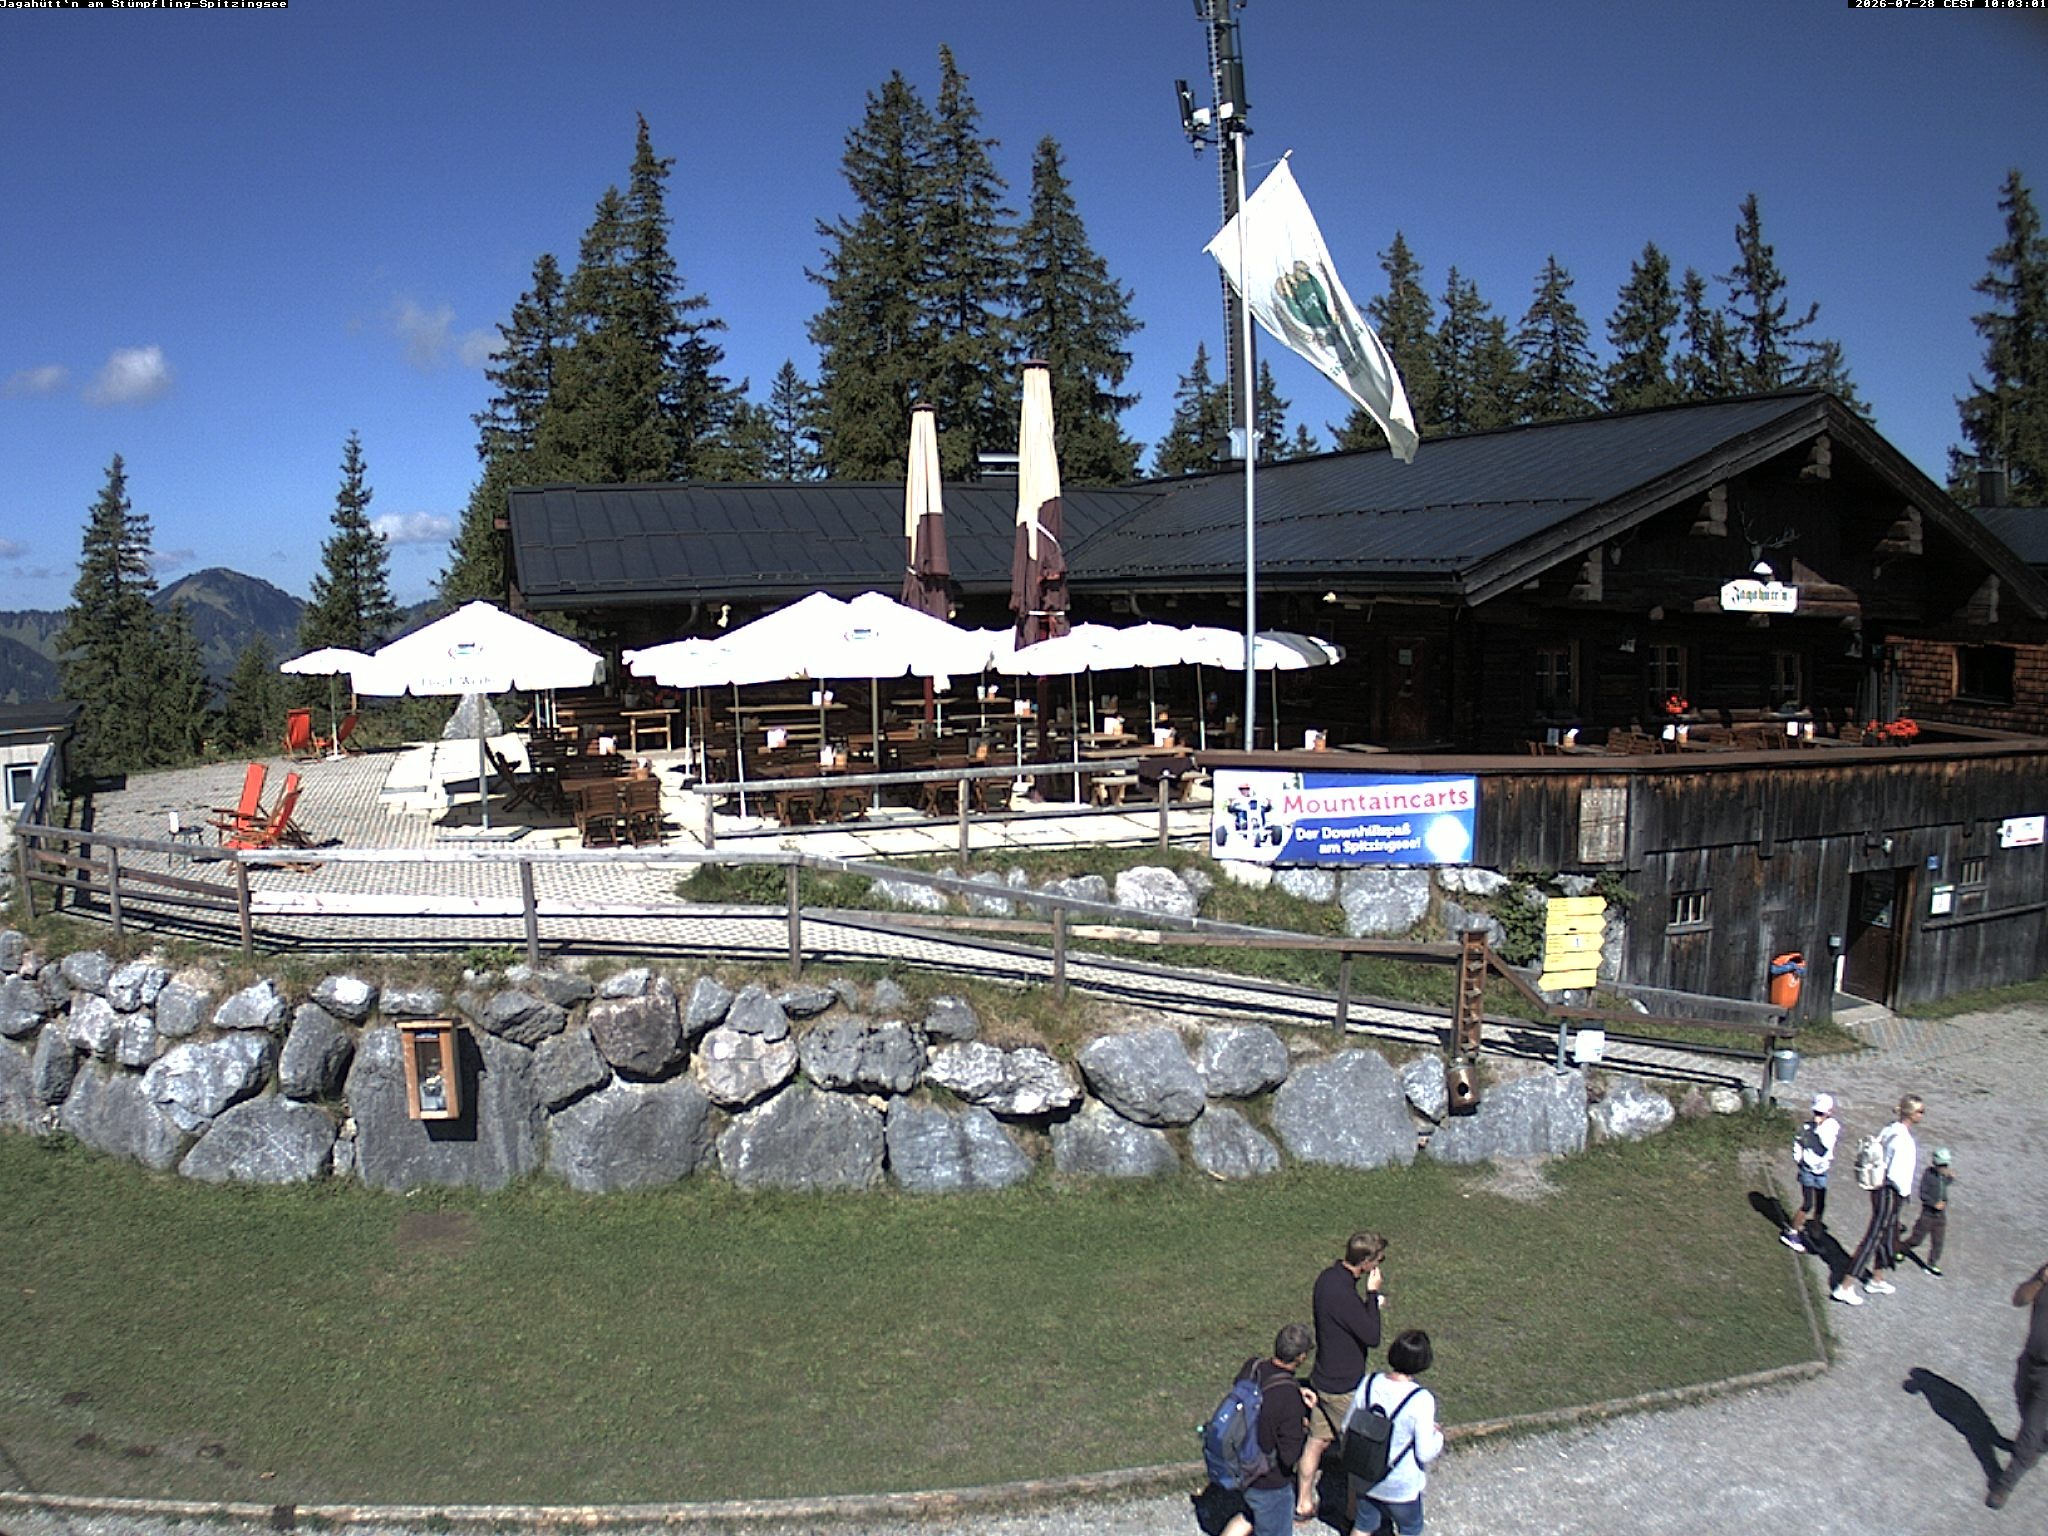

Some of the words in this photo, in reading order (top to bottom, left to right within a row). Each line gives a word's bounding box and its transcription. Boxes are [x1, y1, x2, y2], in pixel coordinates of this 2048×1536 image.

[1284, 788, 1468, 814] Mountaincarts
[1295, 827, 1320, 841] Der
[1319, 843, 1342, 855] am
